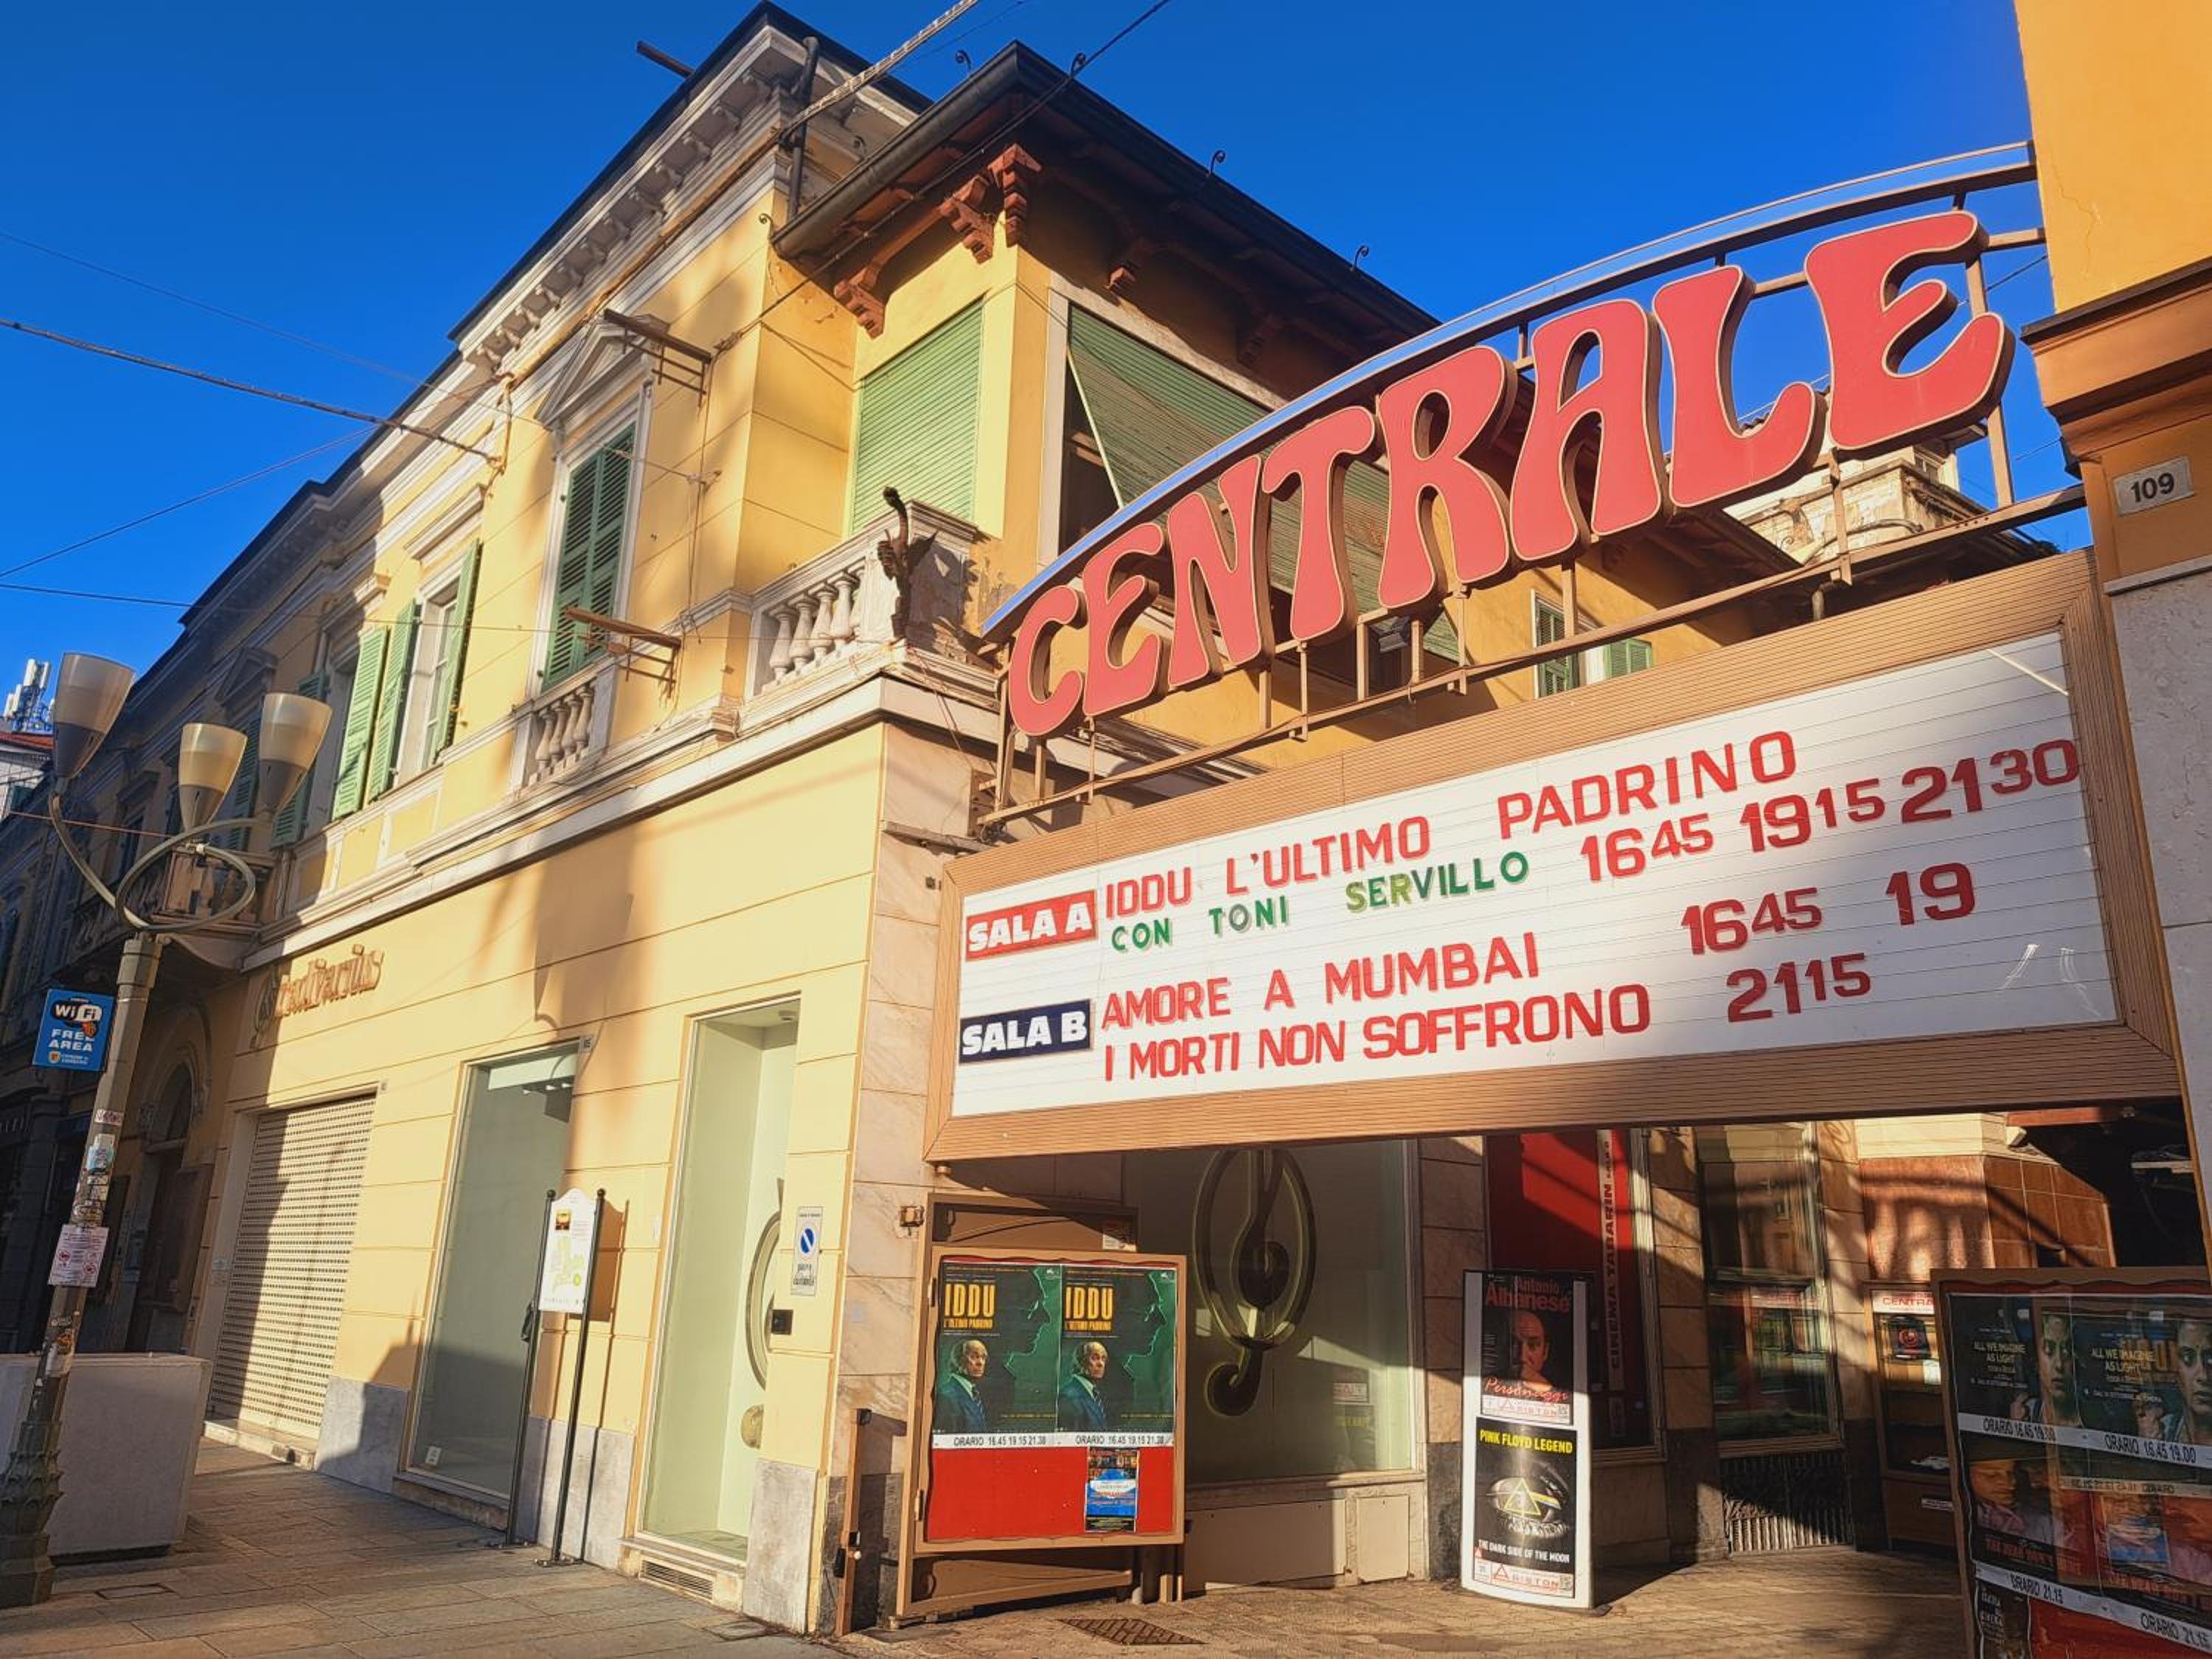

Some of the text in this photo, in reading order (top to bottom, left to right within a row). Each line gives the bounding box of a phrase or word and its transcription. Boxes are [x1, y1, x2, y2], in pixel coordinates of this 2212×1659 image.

[1009, 210, 2006, 737] CENTRALE
[2130, 473, 2174, 503] 109
[1105, 731, 1796, 919] IDDU L'ULTIMO PADRINO
[1111, 738, 2080, 952] CON TONI SERVILLO 1645 1915 2130
[967, 901, 1094, 951] SALA A
[1102, 863, 1976, 1031] AMORE A MUMBAI 1645 19
[1105, 953, 1872, 1081] I MORTI NON SOFFRONO 2115
[48, 1039, 93, 1052] AREA
[961, 1011, 1088, 1056] SALA B
[1604, 1184, 1615, 1276] TABARIN
[1486, 1283, 1570, 1312] Albanese
[1514, 1276, 1560, 1294] Antonio
[945, 1284, 995, 1318] IDDU
[1065, 1287, 1113, 1321] IDDU
[1608, 1284, 1620, 1369] CINEMA
[2104, 1348, 2118, 1360] WE
[2104, 1360, 2116, 1371] AS
[1075, 1435, 1105, 1444] ORARIO
[1983, 1417, 2014, 1435] ORARIO
[953, 1437, 984, 1447] ORARIO
[1480, 1429, 1573, 1454] PINK FLOYD LEGEND
[2104, 1434, 2197, 1464] ORARIO 16.45 19.00
[1478, 1539, 1570, 1564] THE DARK SIDE OF THE MOON
[2008, 1573, 2064, 1605] ORARIO 21.15
[2140, 1613, 2180, 1640] ORARIO
